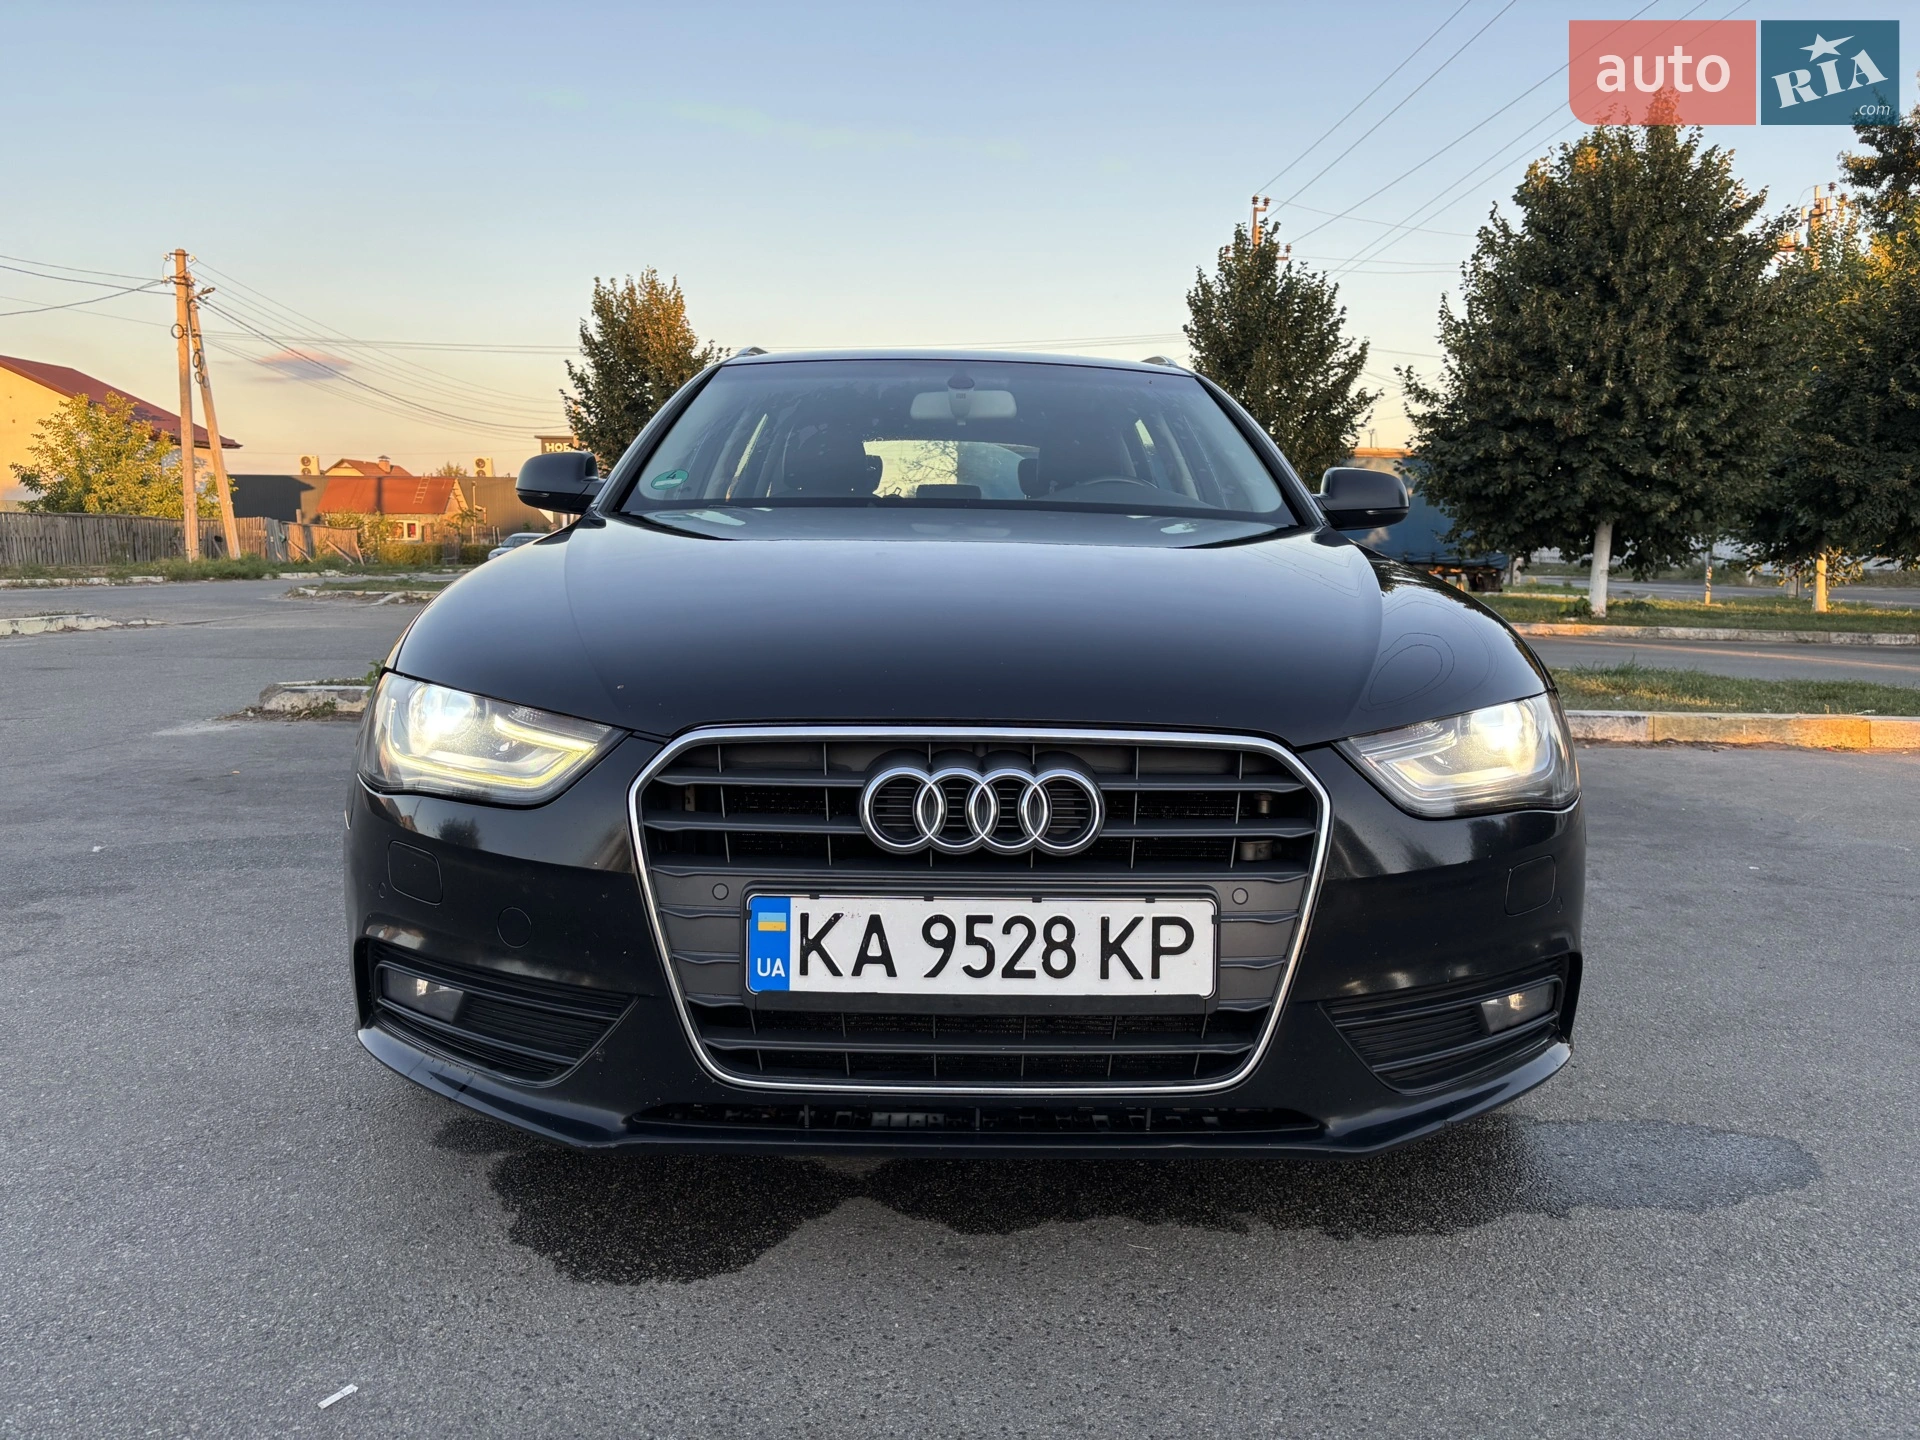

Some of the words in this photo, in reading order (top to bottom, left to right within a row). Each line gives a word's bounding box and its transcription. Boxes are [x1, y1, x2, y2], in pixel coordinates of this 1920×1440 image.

[666, 471, 677, 479] 4
[799, 912, 898, 978] KA
[921, 914, 1077, 979] 9528
[1099, 915, 1195, 980] KP
[757, 957, 786, 978] UA
